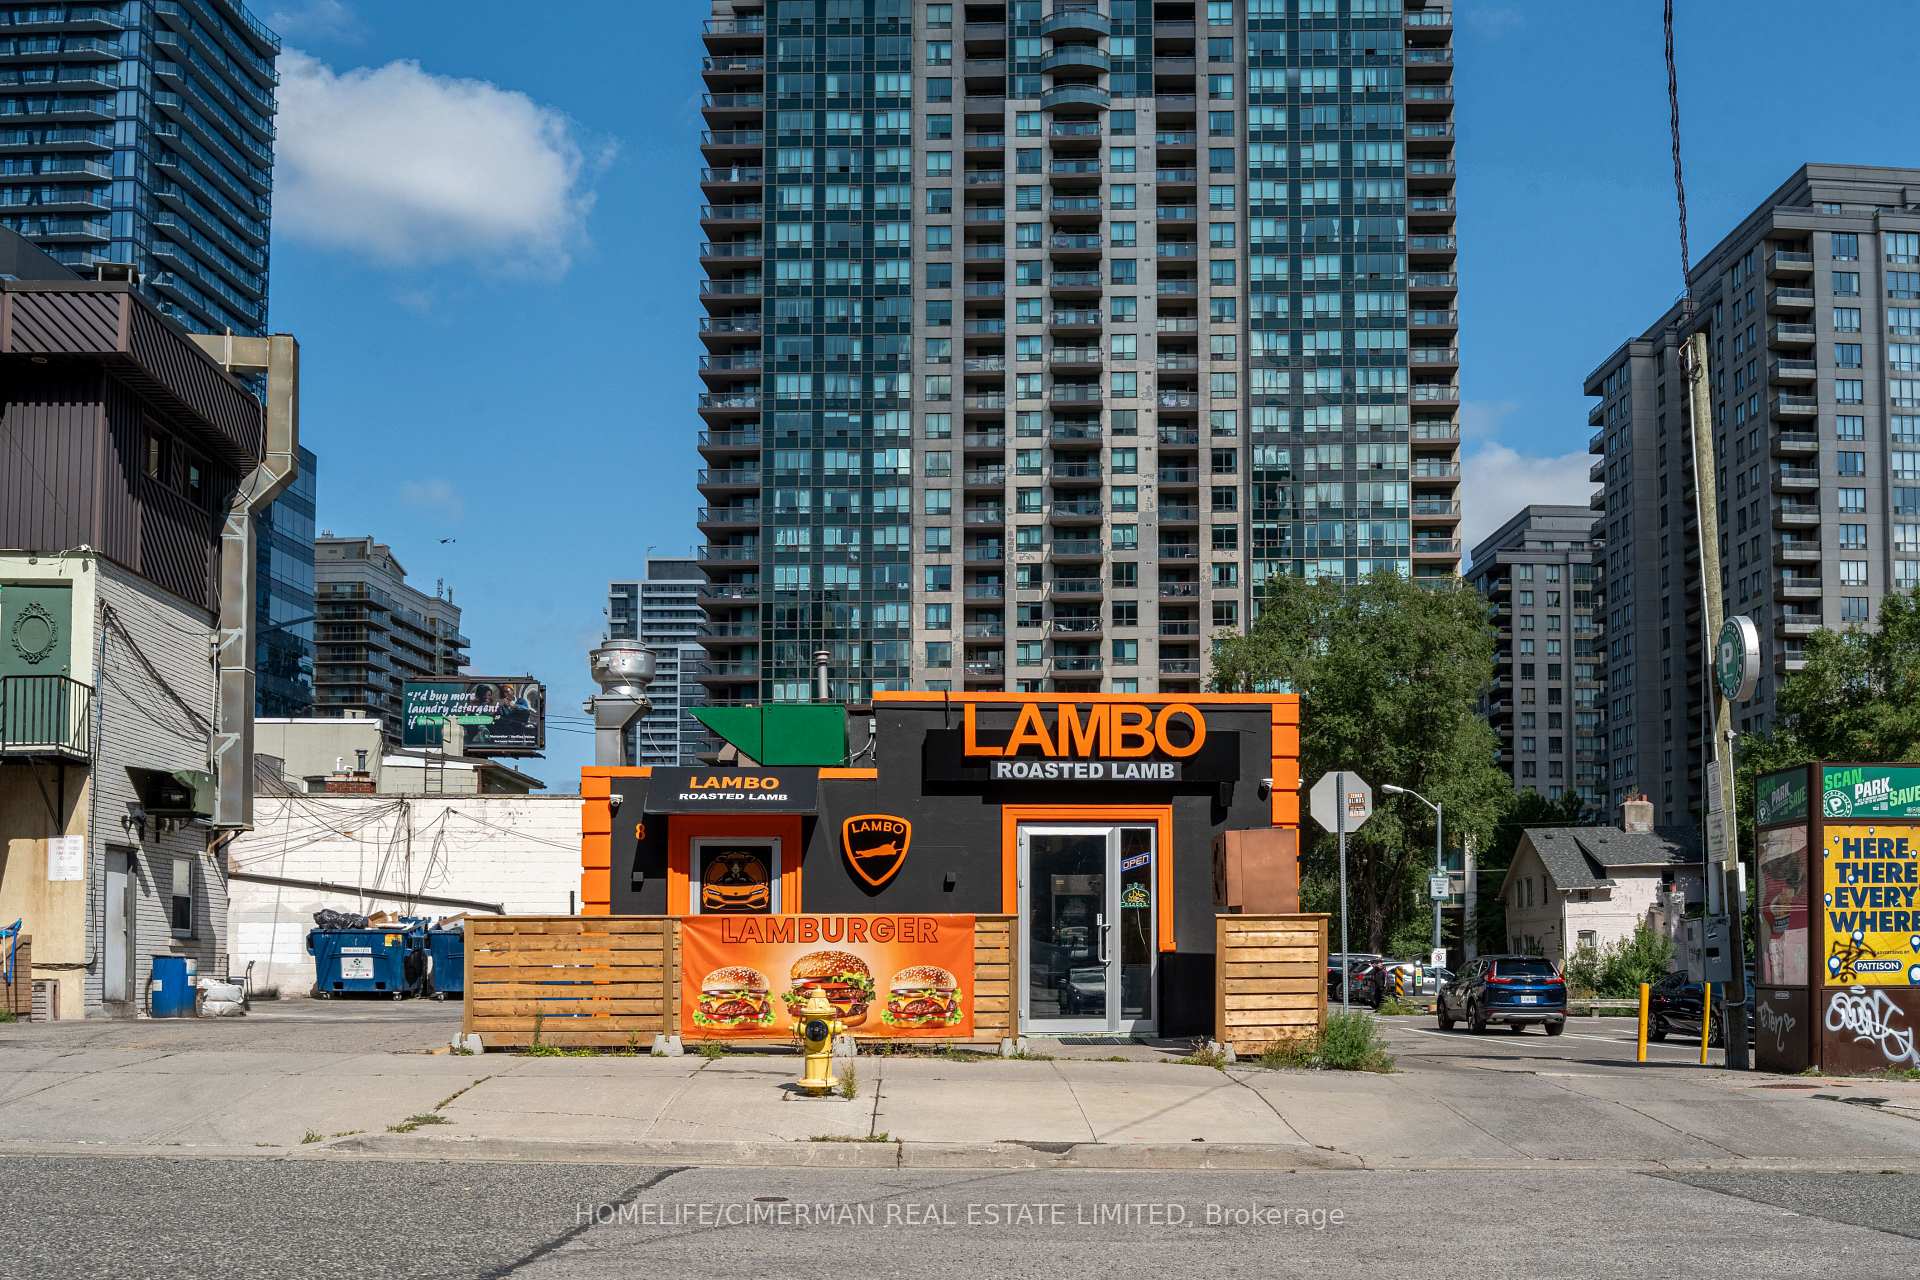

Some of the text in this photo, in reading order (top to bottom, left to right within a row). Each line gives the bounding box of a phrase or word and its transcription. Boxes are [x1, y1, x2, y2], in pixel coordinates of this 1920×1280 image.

[429, 691, 449, 705] buy
[451, 692, 476, 701] more
[408, 702, 500, 716] laundry detergent
[408, 715, 417, 730] if
[963, 703, 1207, 758] LAMBO
[996, 762, 1175, 780] ROASTED LAMB
[689, 776, 781, 790] LAMBO
[748, 793, 788, 801] LAMB
[635, 823, 646, 841] 8
[851, 821, 904, 835] LAMBO
[1842, 837, 1909, 859] HERE
[1835, 862, 1918, 883] THERE
[1835, 886, 1918, 908] EVERY
[721, 916, 939, 944] LAMBURGER
[1829, 911, 1920, 932] WHERE
[1857, 962, 1899, 970] PATTISON
